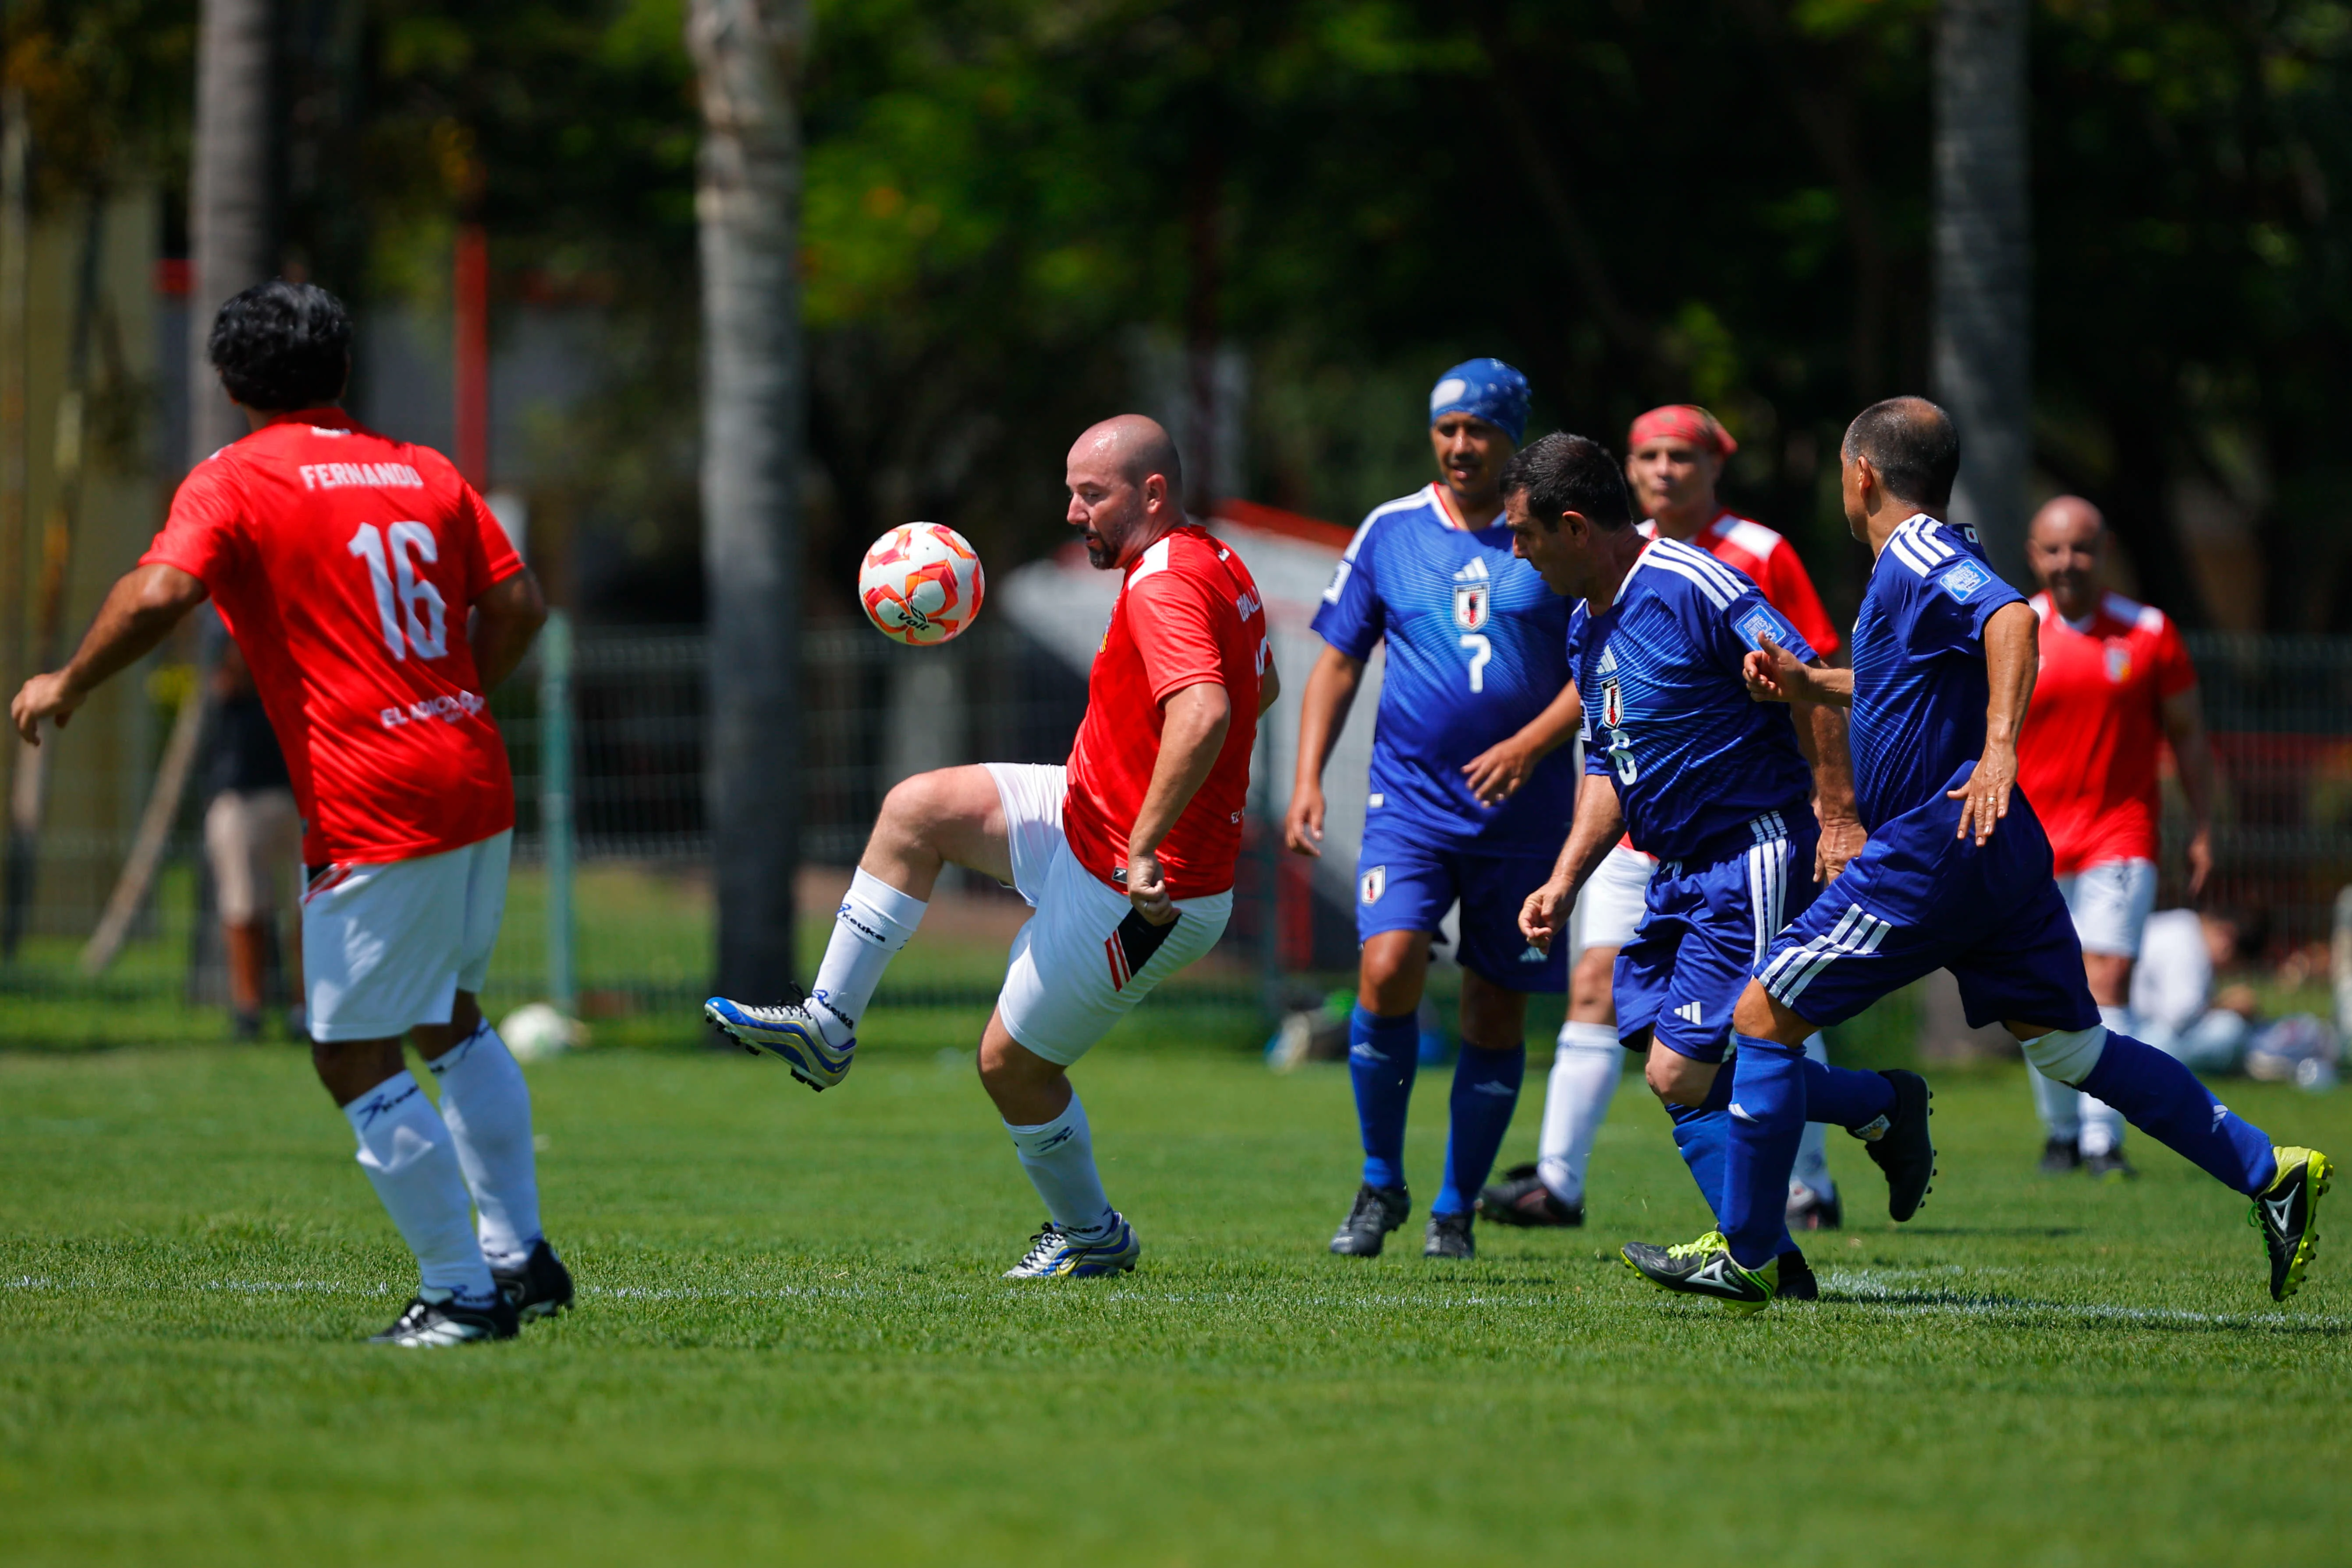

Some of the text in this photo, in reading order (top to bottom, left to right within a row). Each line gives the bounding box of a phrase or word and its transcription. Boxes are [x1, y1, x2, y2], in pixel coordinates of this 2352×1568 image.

[300, 462, 423, 490] FERNANDO
[348, 521, 448, 662] 16
[1460, 634, 1491, 693] 7
